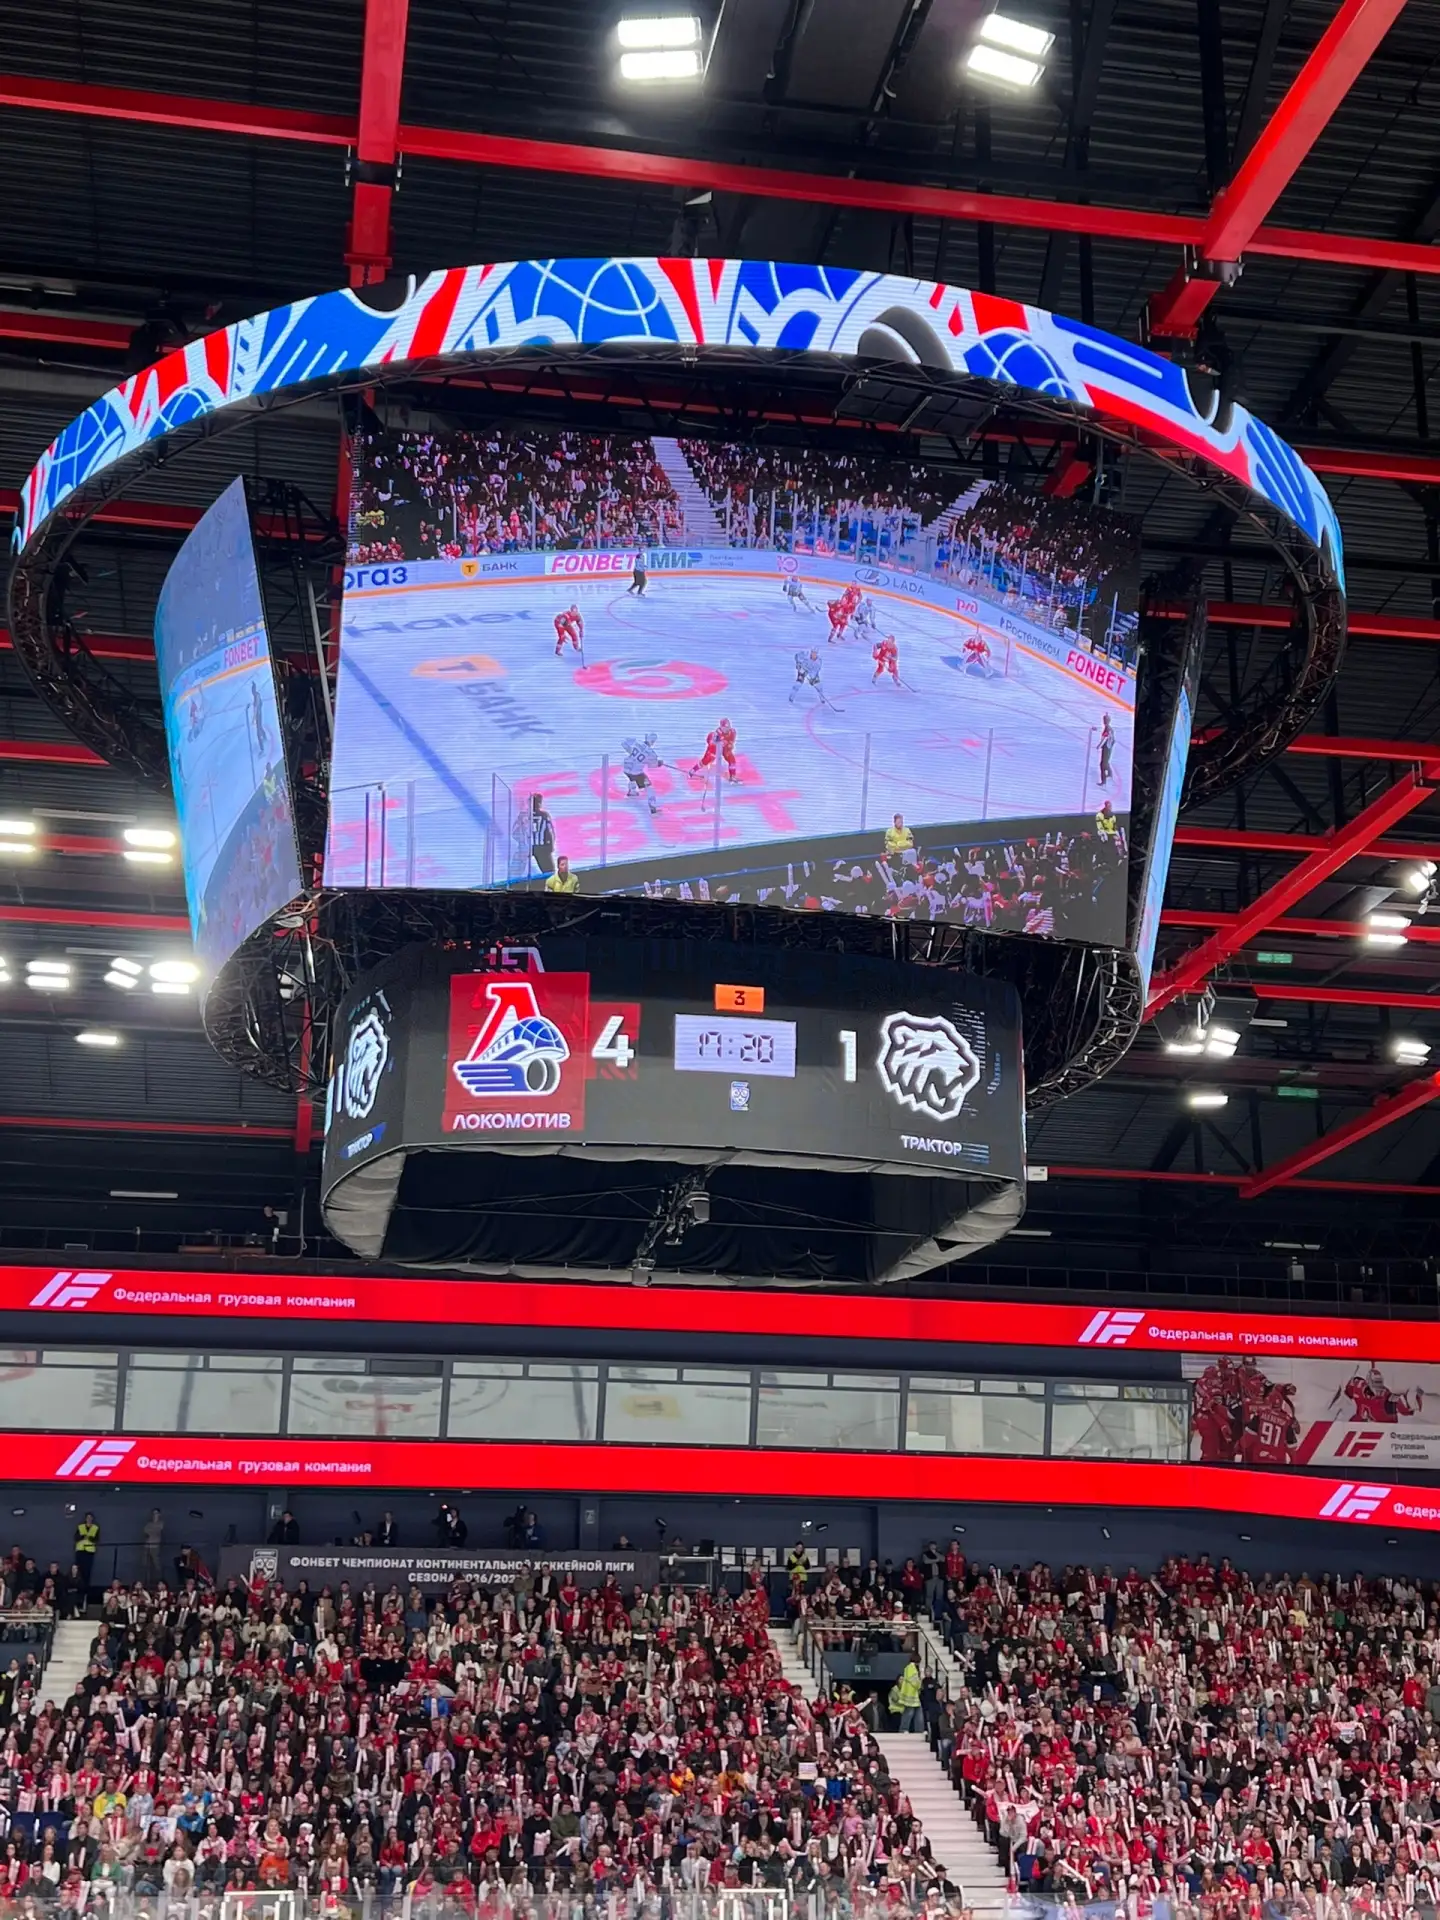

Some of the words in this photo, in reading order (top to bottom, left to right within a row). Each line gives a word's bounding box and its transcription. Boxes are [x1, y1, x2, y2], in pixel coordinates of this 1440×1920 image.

[482, 562, 518, 572] БАНК
[551, 553, 636, 573] FONBET
[892, 577, 925, 596] LADA
[224, 636, 260, 669] FONBET
[1066, 650, 1127, 694] FONBET
[734, 990, 746, 1006] 3
[591, 1015, 635, 1067] 4
[699, 1031, 774, 1063] 17:20
[839, 1030, 857, 1082] 1
[453, 1113, 571, 1130] ЛОКОМОТИВ
[900, 1135, 962, 1155] ТРАКТОР
[114, 1287, 211, 1304] Федеральная
[218, 1294, 281, 1307] грузовая
[287, 1296, 356, 1308] компания
[1148, 1326, 1233, 1342] Федеральная
[1239, 1332, 1294, 1345] грузовая
[1299, 1335, 1358, 1347] компания
[1260, 1421, 1282, 1447] 91
[137, 1456, 232, 1473] Федеральная
[238, 1460, 300, 1474] грузовая
[305, 1462, 372, 1473] компания
[290, 1556, 340, 1568] ФОНБЕТ
[342, 1557, 415, 1569] ЧЕМПИОНАТ
[605, 1562, 635, 1572] ЛИГИ
[408, 1572, 454, 1583] СЕЗОНА
